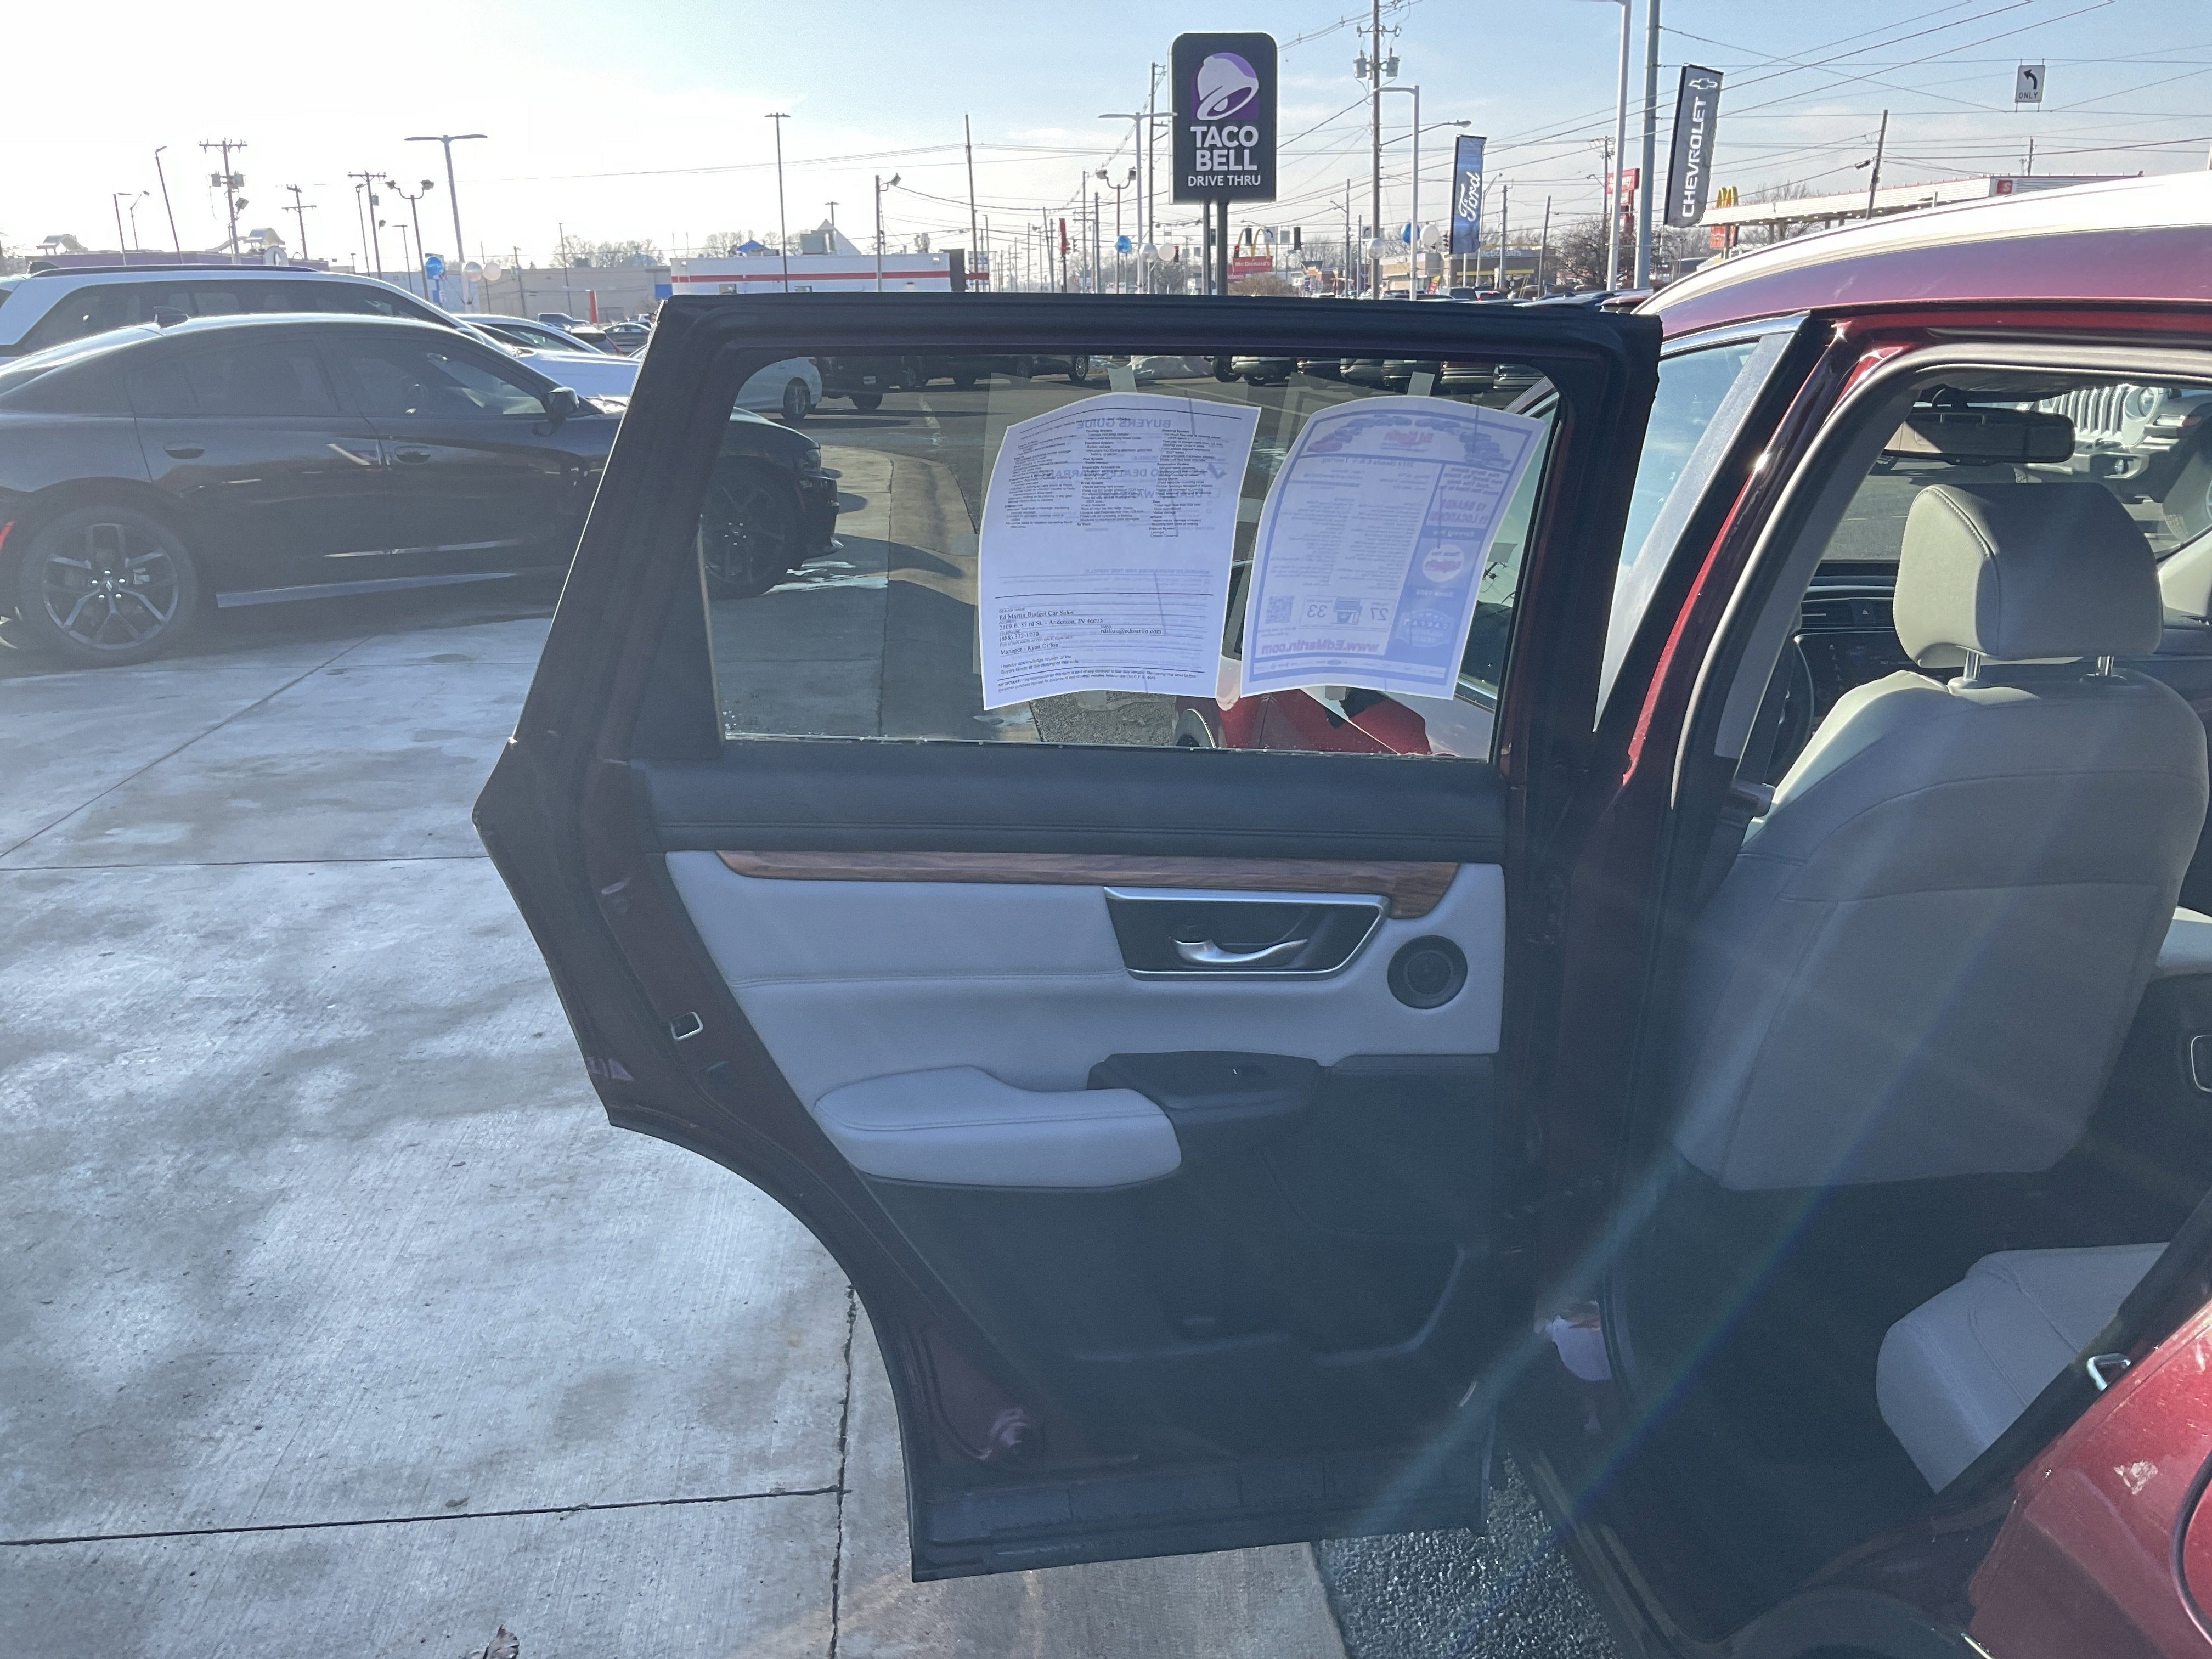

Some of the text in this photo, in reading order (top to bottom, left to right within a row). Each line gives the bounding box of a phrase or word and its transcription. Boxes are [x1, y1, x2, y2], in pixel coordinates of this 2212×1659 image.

[1190, 126, 1259, 148] TACO
[1195, 149, 1258, 172] BELL
[1681, 96, 1707, 218] CHEVROLET
[1187, 175, 1261, 187] DRIVE THRU
[1459, 171, 1481, 222] Ford
[1000, 647, 1023, 655] Manager
